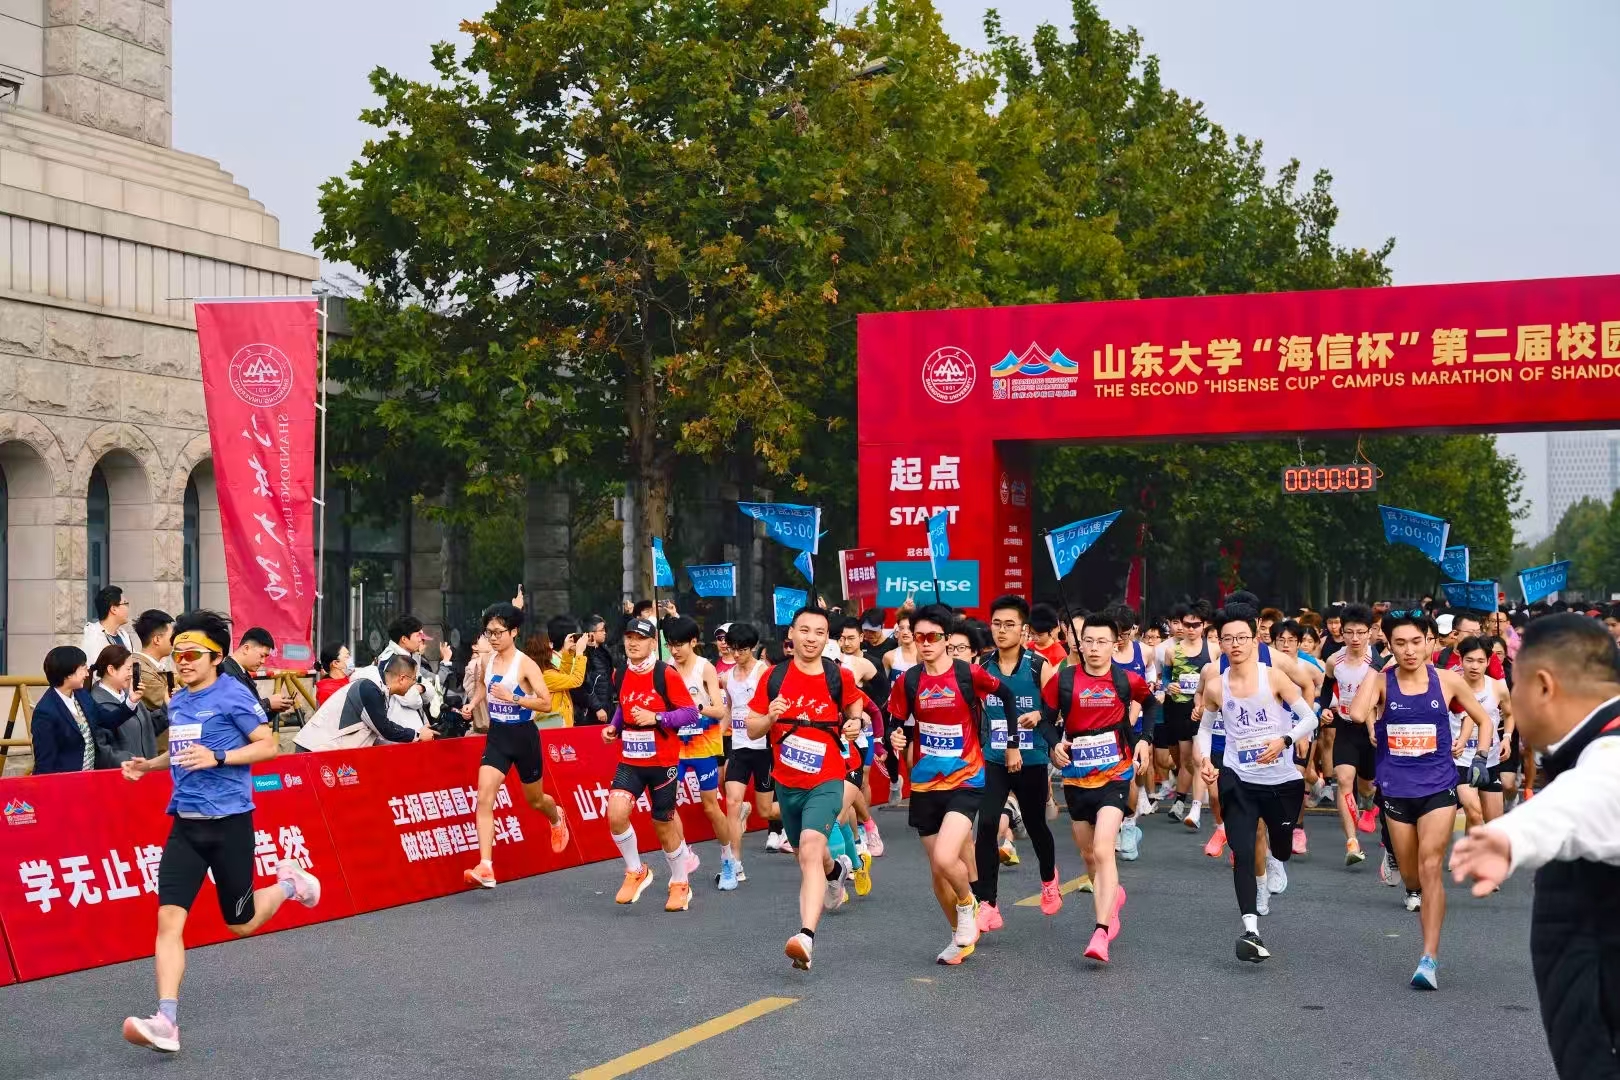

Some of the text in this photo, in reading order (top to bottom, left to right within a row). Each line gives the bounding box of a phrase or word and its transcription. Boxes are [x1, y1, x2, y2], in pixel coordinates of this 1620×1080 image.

[1094, 384, 1125, 398] THE
[1130, 381, 1199, 397] SECOND
[1204, 377, 1280, 394] "HISENSE
[1285, 375, 1326, 391] CUP"
[1332, 372, 1405, 389] CAMPUS
[1412, 368, 1513, 386] MARATHON
[1519, 366, 1545, 382] OF
[890, 455, 961, 492] 起点
[1285, 467, 1372, 492] 00:00:03
[1390, 524, 1441, 548] 2:00:00
[885, 576, 971, 593] Hisense
[388, 783, 513, 826] 立报国强国大问
[400, 815, 525, 863] 做挺膺担当斗者
